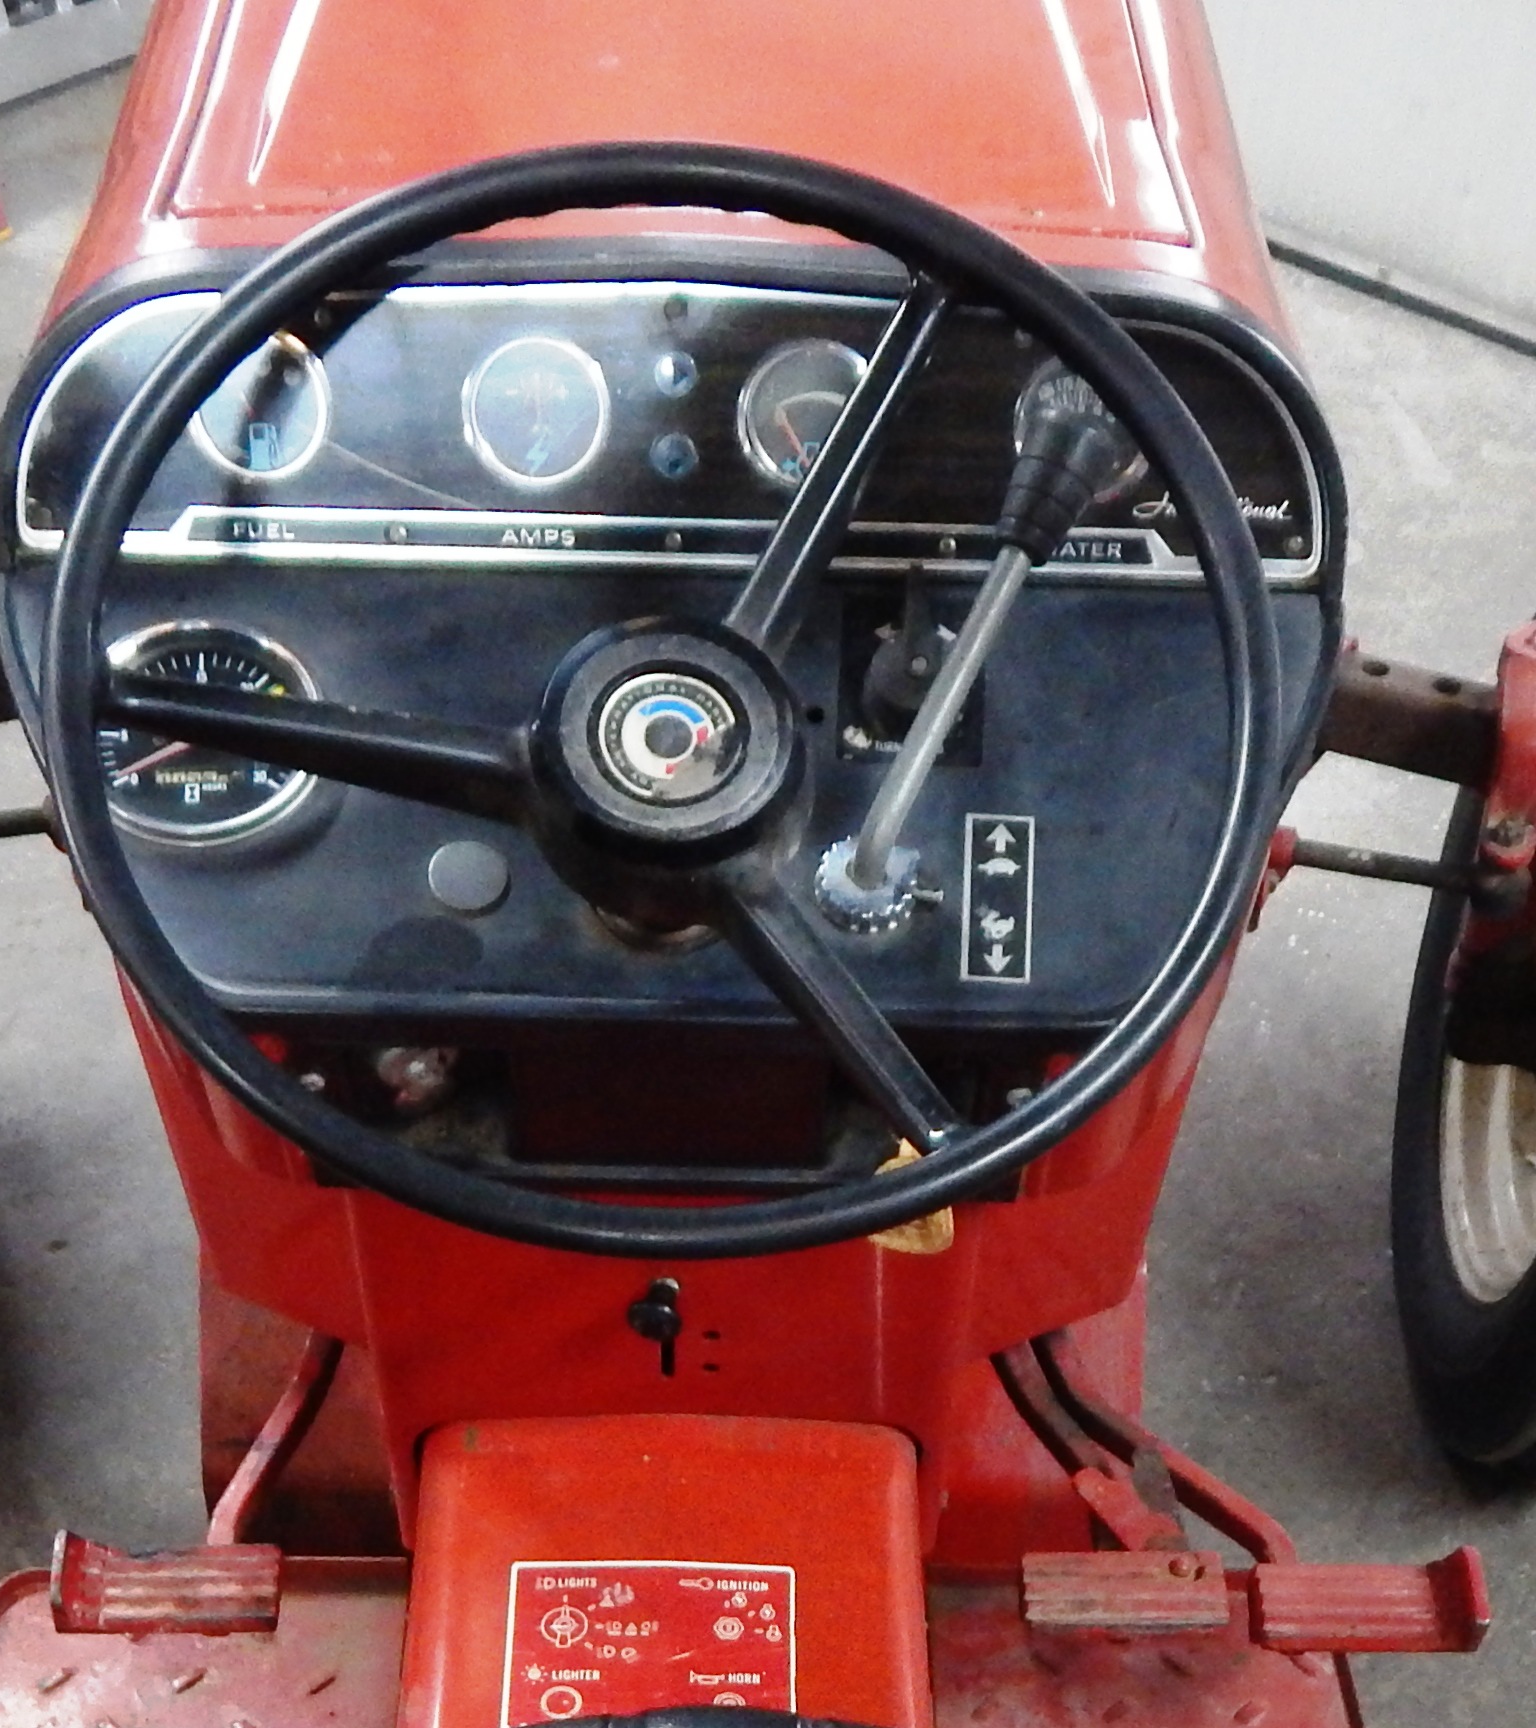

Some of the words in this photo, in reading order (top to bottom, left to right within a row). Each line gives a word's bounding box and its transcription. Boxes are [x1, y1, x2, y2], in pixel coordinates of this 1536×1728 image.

[232, 521, 295, 540] FUEL
[500, 528, 576, 546] AMPS
[1051, 541, 1122, 558] ATER
[557, 1576, 598, 1589] LIGHTS
[716, 1578, 770, 1592] IGNITION
[551, 1669, 601, 1682] LIGHTER
[727, 1672, 762, 1685] HORN
